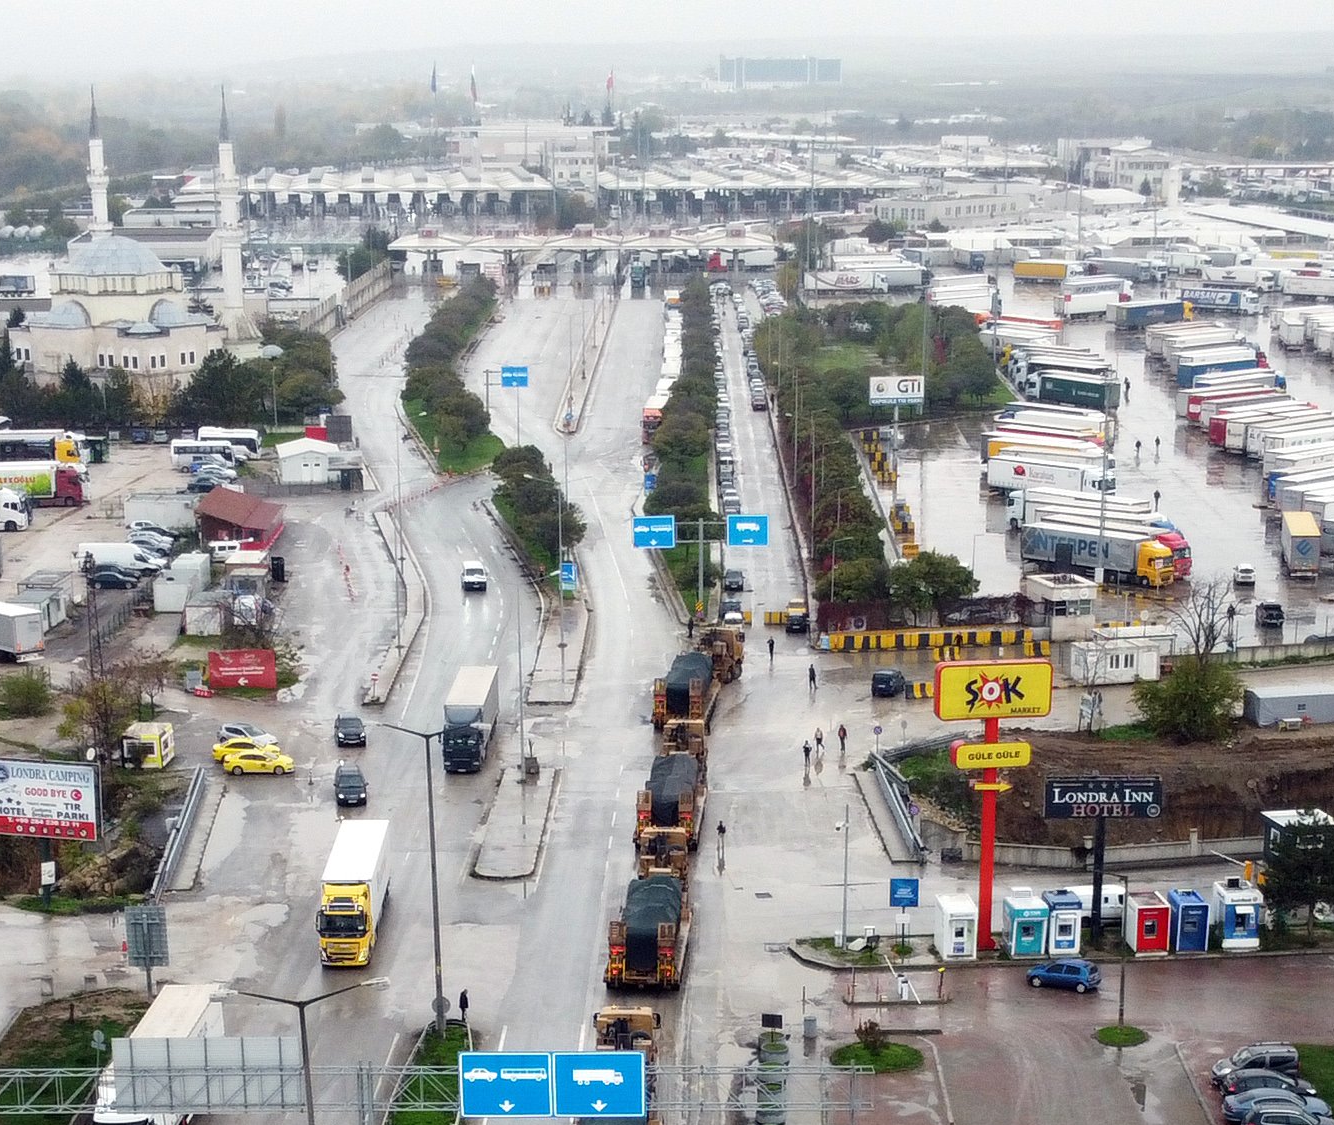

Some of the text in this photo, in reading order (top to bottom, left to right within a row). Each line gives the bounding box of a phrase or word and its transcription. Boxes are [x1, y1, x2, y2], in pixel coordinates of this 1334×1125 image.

[1183, 289, 1217, 300] BARSAN
[965, 673, 1026, 713] ŞOK
[968, 751, 993, 761] GÜLE
[11, 766, 90, 784] LONDRA CAMPING
[25, 787, 48, 797] GOOD
[50, 788, 67, 798] BYE
[64, 802, 81, 812] TIR
[1072, 804, 1135, 817] HOTEL
